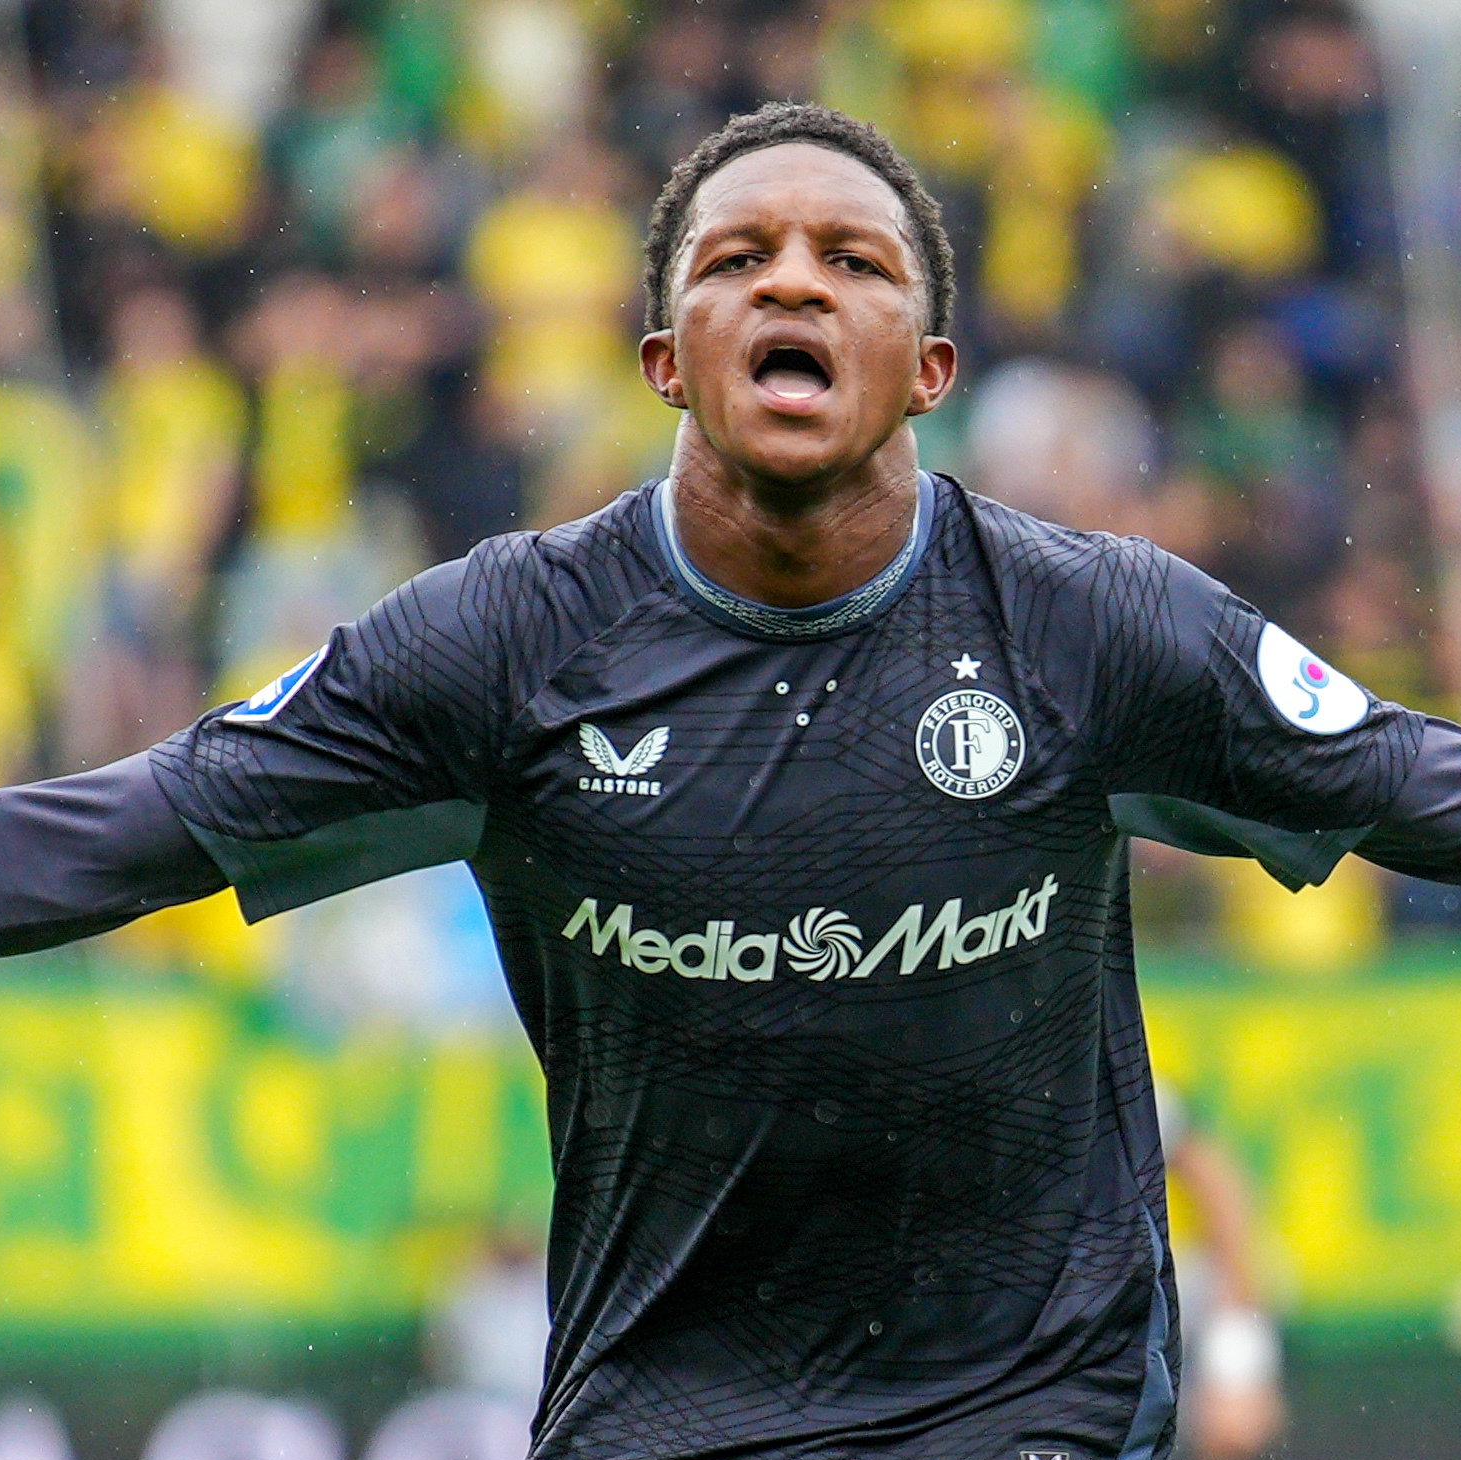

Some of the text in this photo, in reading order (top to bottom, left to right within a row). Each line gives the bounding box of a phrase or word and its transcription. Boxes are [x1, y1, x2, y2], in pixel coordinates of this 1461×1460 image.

[924, 694, 1015, 731] FEYENOORD
[578, 776, 662, 796] CASTORE
[924, 758, 1017, 795] ROTTERDAM
[560, 872, 1060, 983] Media Markt
